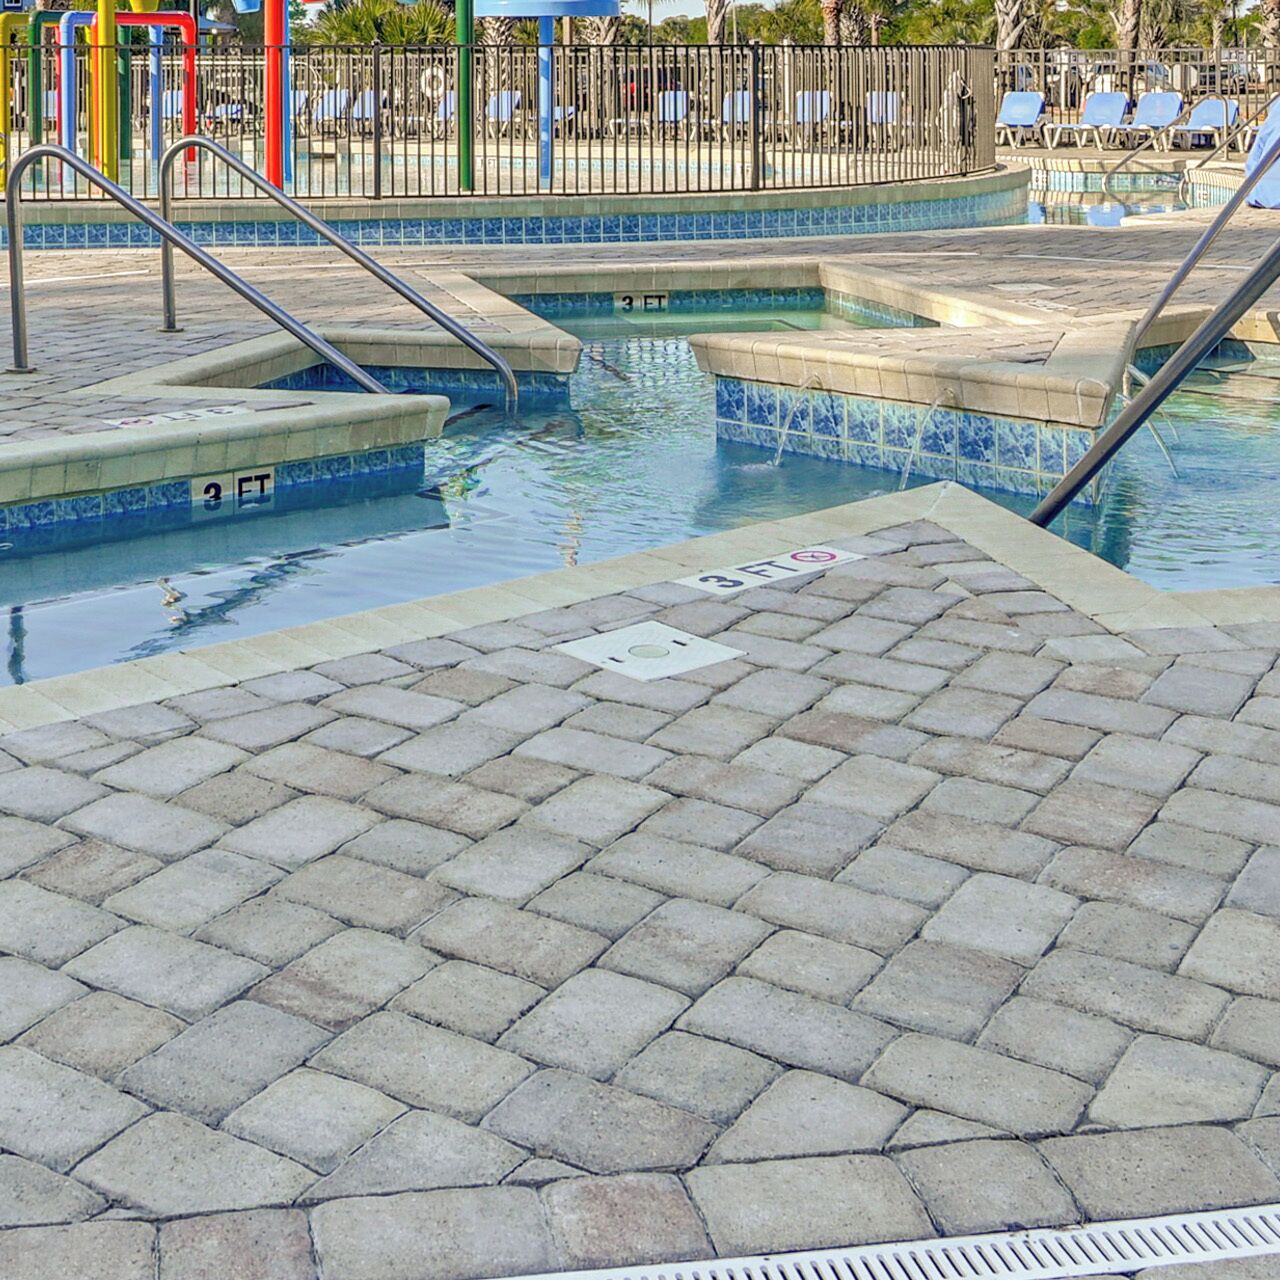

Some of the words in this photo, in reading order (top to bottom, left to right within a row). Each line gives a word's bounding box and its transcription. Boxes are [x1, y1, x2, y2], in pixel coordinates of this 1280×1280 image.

[238, 473, 271, 501] FT
[698, 575, 745, 588] 3
[735, 560, 799, 578] FT
